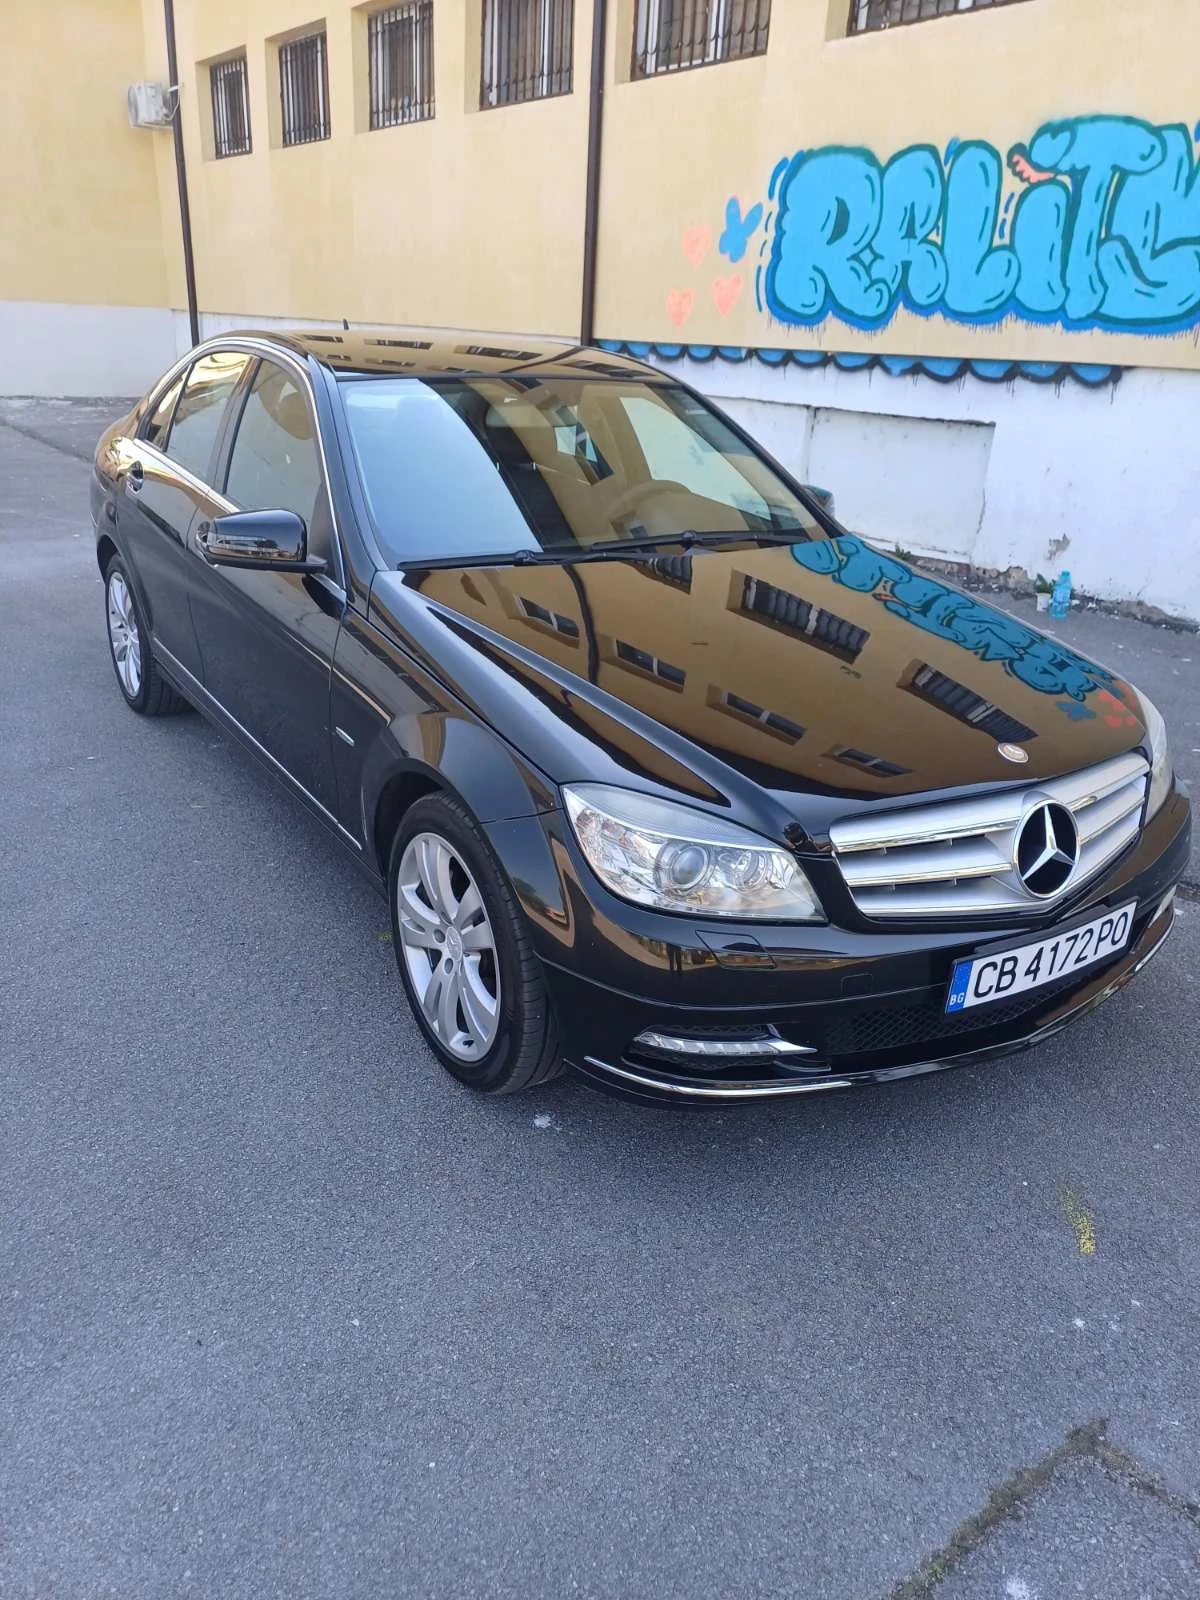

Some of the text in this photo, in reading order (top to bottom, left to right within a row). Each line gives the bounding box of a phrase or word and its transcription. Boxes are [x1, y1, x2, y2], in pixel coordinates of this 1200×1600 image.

[973, 955, 1019, 999] CB
[1024, 927, 1094, 982] 4172
[949, 992, 966, 1006] BG
